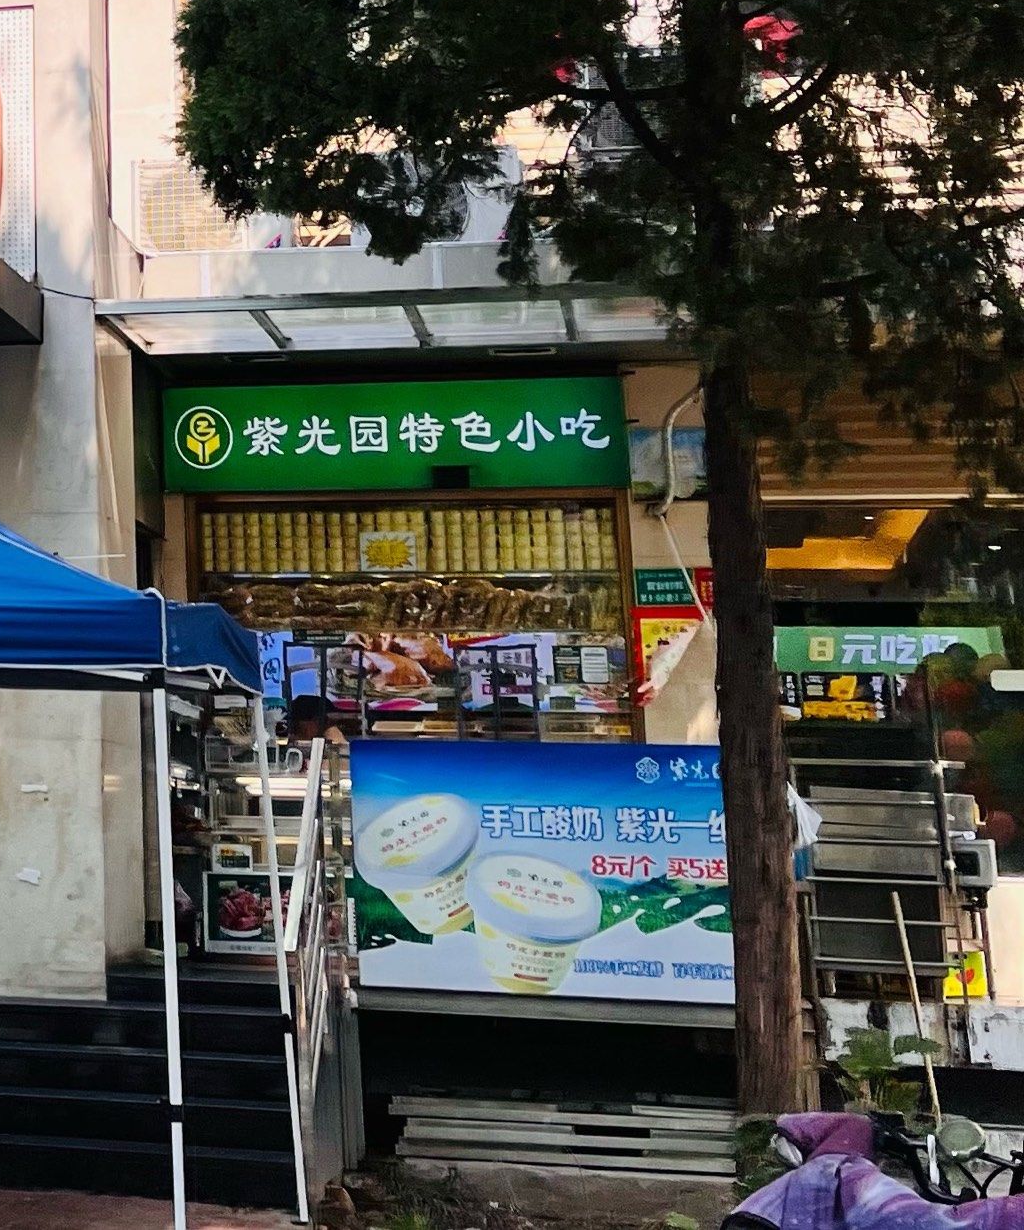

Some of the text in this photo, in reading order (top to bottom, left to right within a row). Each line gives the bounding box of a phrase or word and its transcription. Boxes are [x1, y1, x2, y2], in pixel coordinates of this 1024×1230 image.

[242, 407, 611, 457] 紫光园特色小吃
[481, 804, 604, 843] 手工酸奶
[591, 855, 728, 879] 8元/个 买5送
